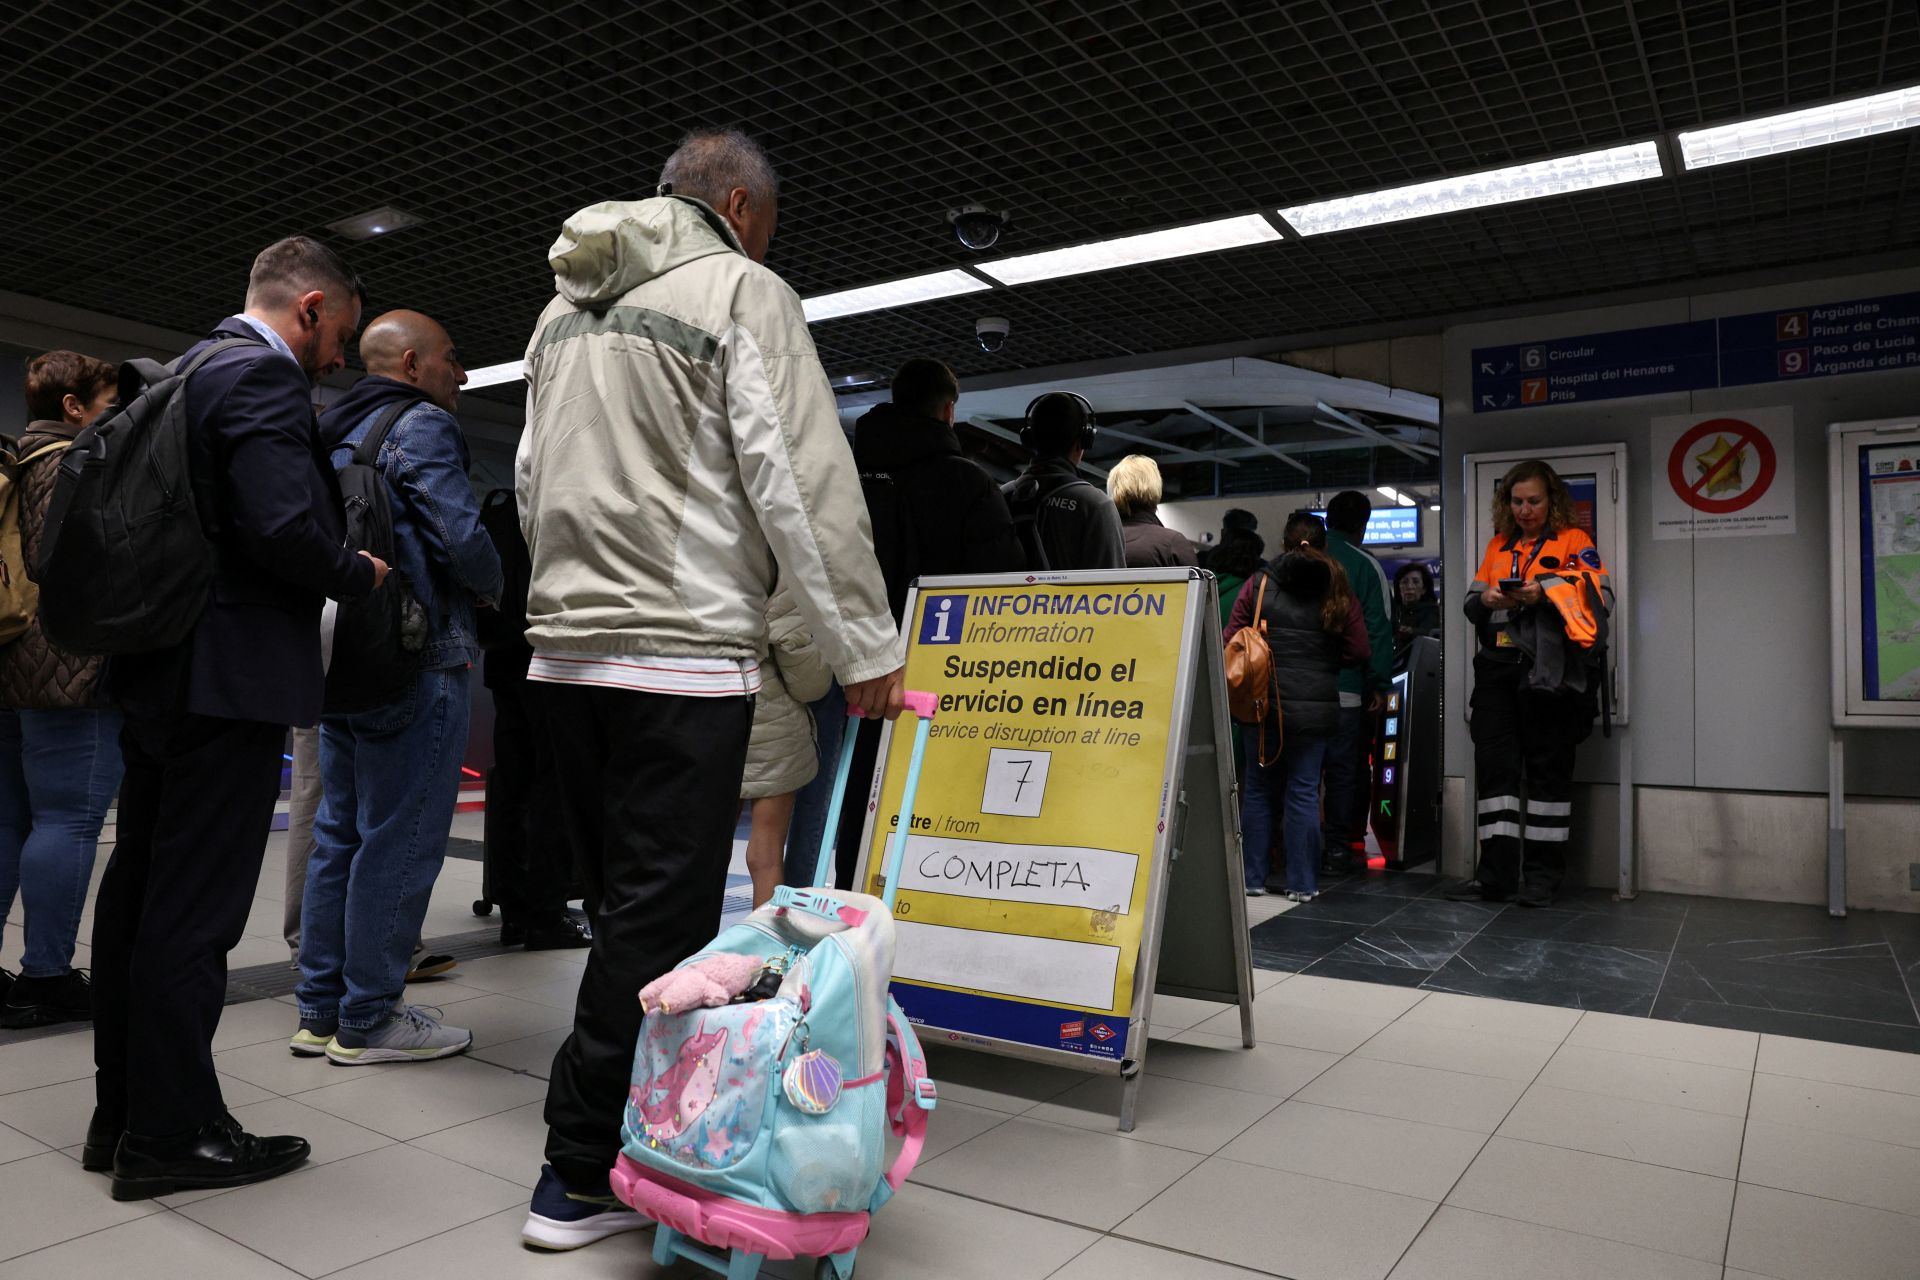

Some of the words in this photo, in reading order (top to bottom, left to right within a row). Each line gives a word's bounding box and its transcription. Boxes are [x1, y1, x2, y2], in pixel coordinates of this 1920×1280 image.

[1811, 303, 1880, 321] Argüelles
[1784, 316, 1801, 336] 4
[1812, 323, 1850, 337] Pinar
[1853, 320, 1872, 332] de
[1526, 348, 1541, 368] 6
[1549, 345, 1596, 361] Circular
[1813, 343, 1849, 356] Paco
[1852, 340, 1871, 352] de
[1784, 351, 1802, 373] 9
[1813, 357, 1874, 374] Arganda
[1878, 353, 1901, 366] del
[1550, 369, 1598, 386] Hospital
[1602, 367, 1620, 381] del
[1623, 363, 1676, 378] Henares
[1526, 381, 1542, 400] 7
[1550, 389, 1576, 402] Pitis
[971, 587, 1166, 616] INFORMACIÓN
[966, 621, 1095, 644] Information
[943, 654, 1102, 684] Suspendido
[1110, 658, 1137, 682] el
[938, 689, 1024, 714] ervicio
[1032, 694, 1067, 717] en
[1075, 691, 1145, 720] línea
[1389, 695, 1396, 710] 4
[928, 722, 980, 741] ervice
[983, 723, 1077, 748] disruption
[1080, 726, 1099, 745] at
[1104, 728, 1141, 747] line
[1388, 719, 1395, 734] 6
[1387, 744, 1393, 759] 7
[1007, 760, 1034, 803] 7
[1385, 768, 1392, 783] 9
[890, 813, 932, 830] etre
[944, 815, 980, 834] from
[918, 850, 1091, 892] COMPLETA
[895, 899, 911, 915] to
